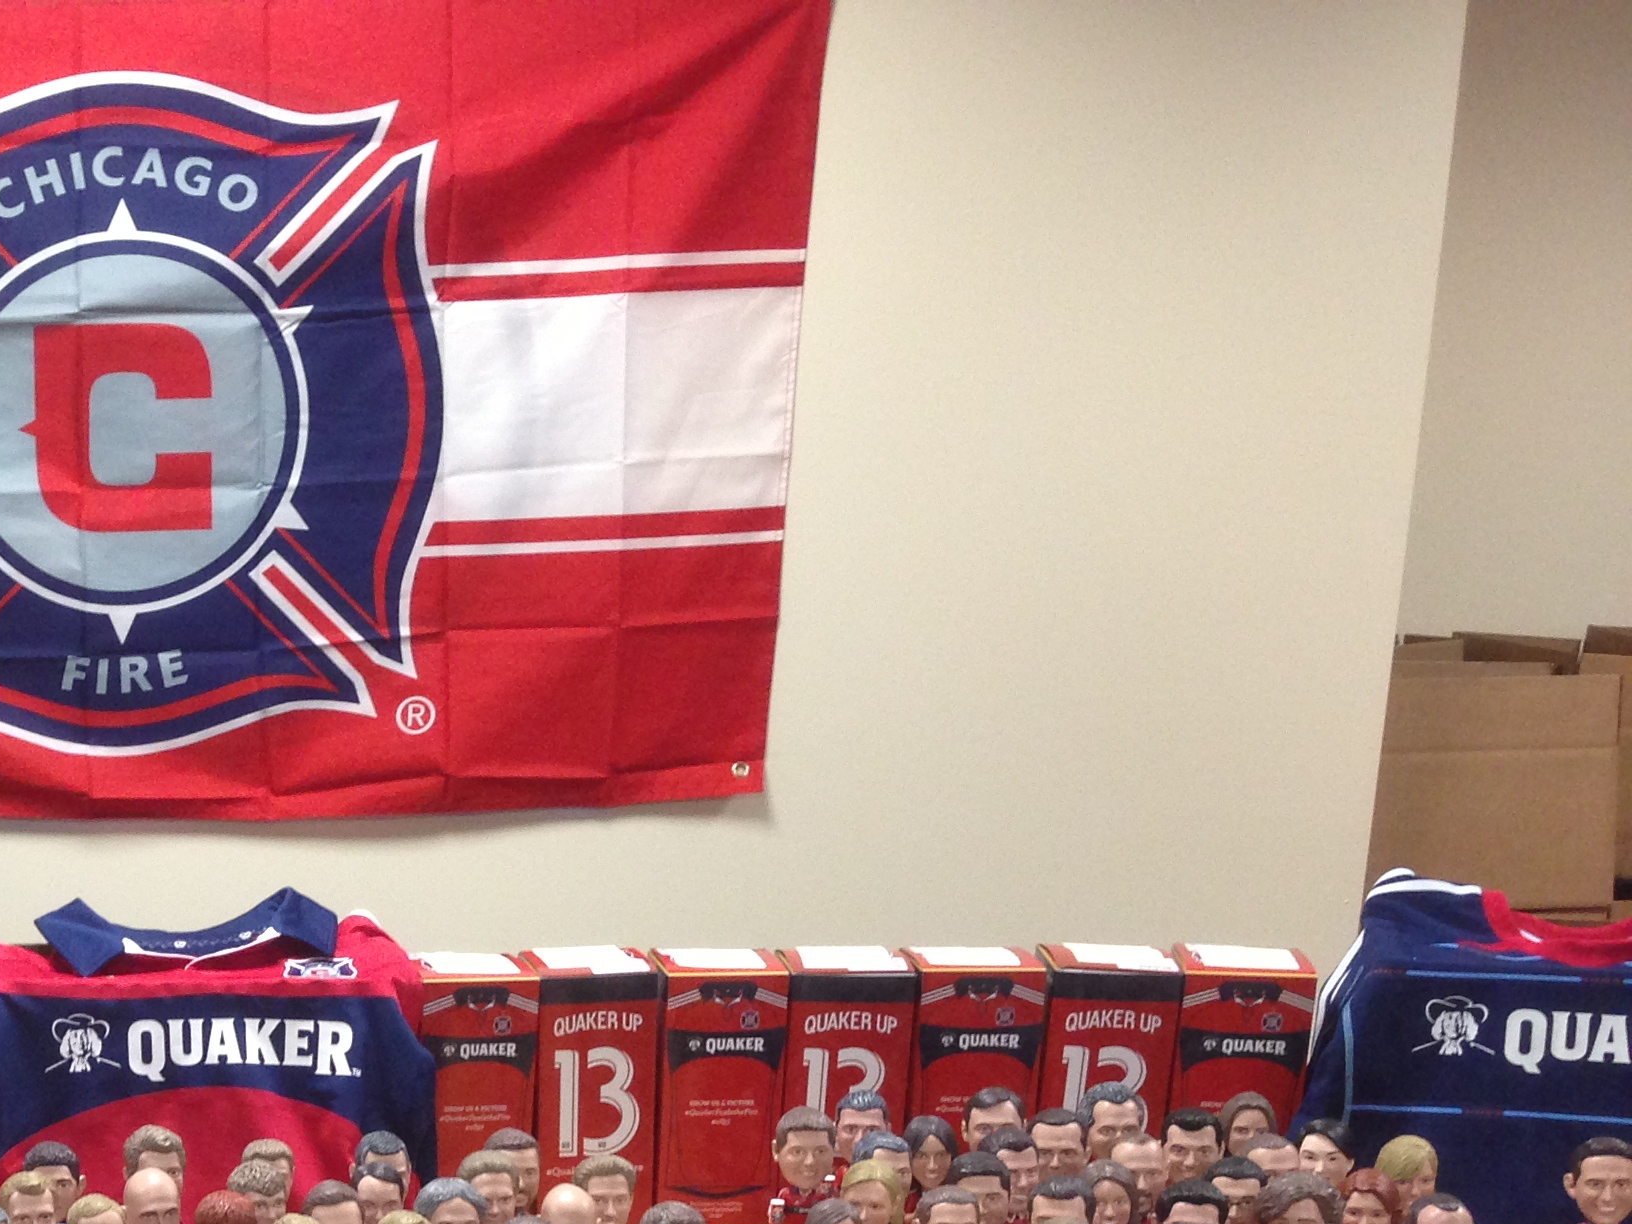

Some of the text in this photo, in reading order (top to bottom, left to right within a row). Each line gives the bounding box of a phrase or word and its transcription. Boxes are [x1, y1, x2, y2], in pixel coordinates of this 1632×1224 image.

[60, 649, 189, 695] FIRE
[554, 1011, 643, 1037] QUAKER UP
[804, 1011, 898, 1035] QUAKER UP
[1065, 1009, 1162, 1034] QUAKER UP
[127, 1018, 352, 1082] QUAKER
[459, 1043, 517, 1059] QUAKER
[705, 1037, 765, 1053] QUAKER
[959, 1034, 1020, 1049] QUAKER
[1222, 1038, 1286, 1056] QUAKER
[1504, 1008, 1632, 1075] QUA
[554, 1046, 641, 1158] 13
